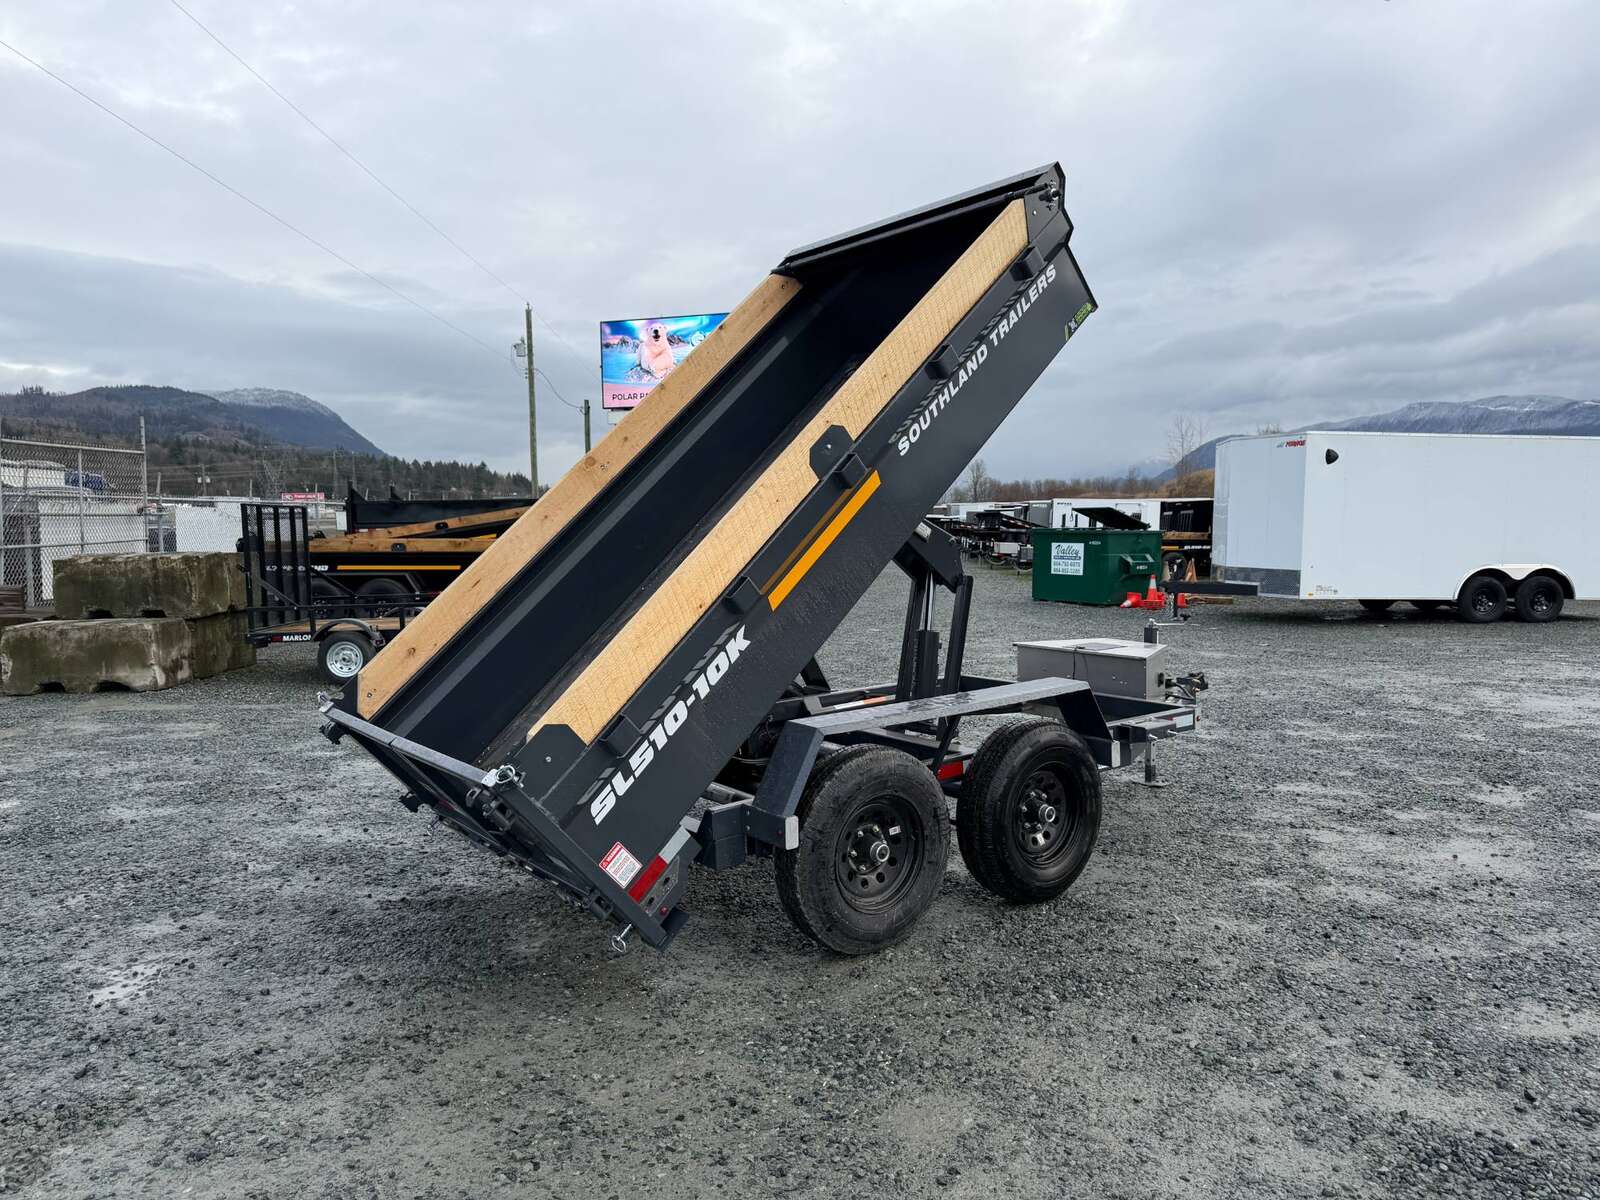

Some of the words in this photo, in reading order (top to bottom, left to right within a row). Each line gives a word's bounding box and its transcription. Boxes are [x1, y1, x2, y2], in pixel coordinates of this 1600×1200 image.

[612, 393, 638, 401] POLAR
[898, 343, 988, 456] SOUTHLAND
[989, 263, 1057, 346] TRAILERS
[1055, 544, 1080, 557] Valley
[590, 624, 751, 826] SL510-10K
